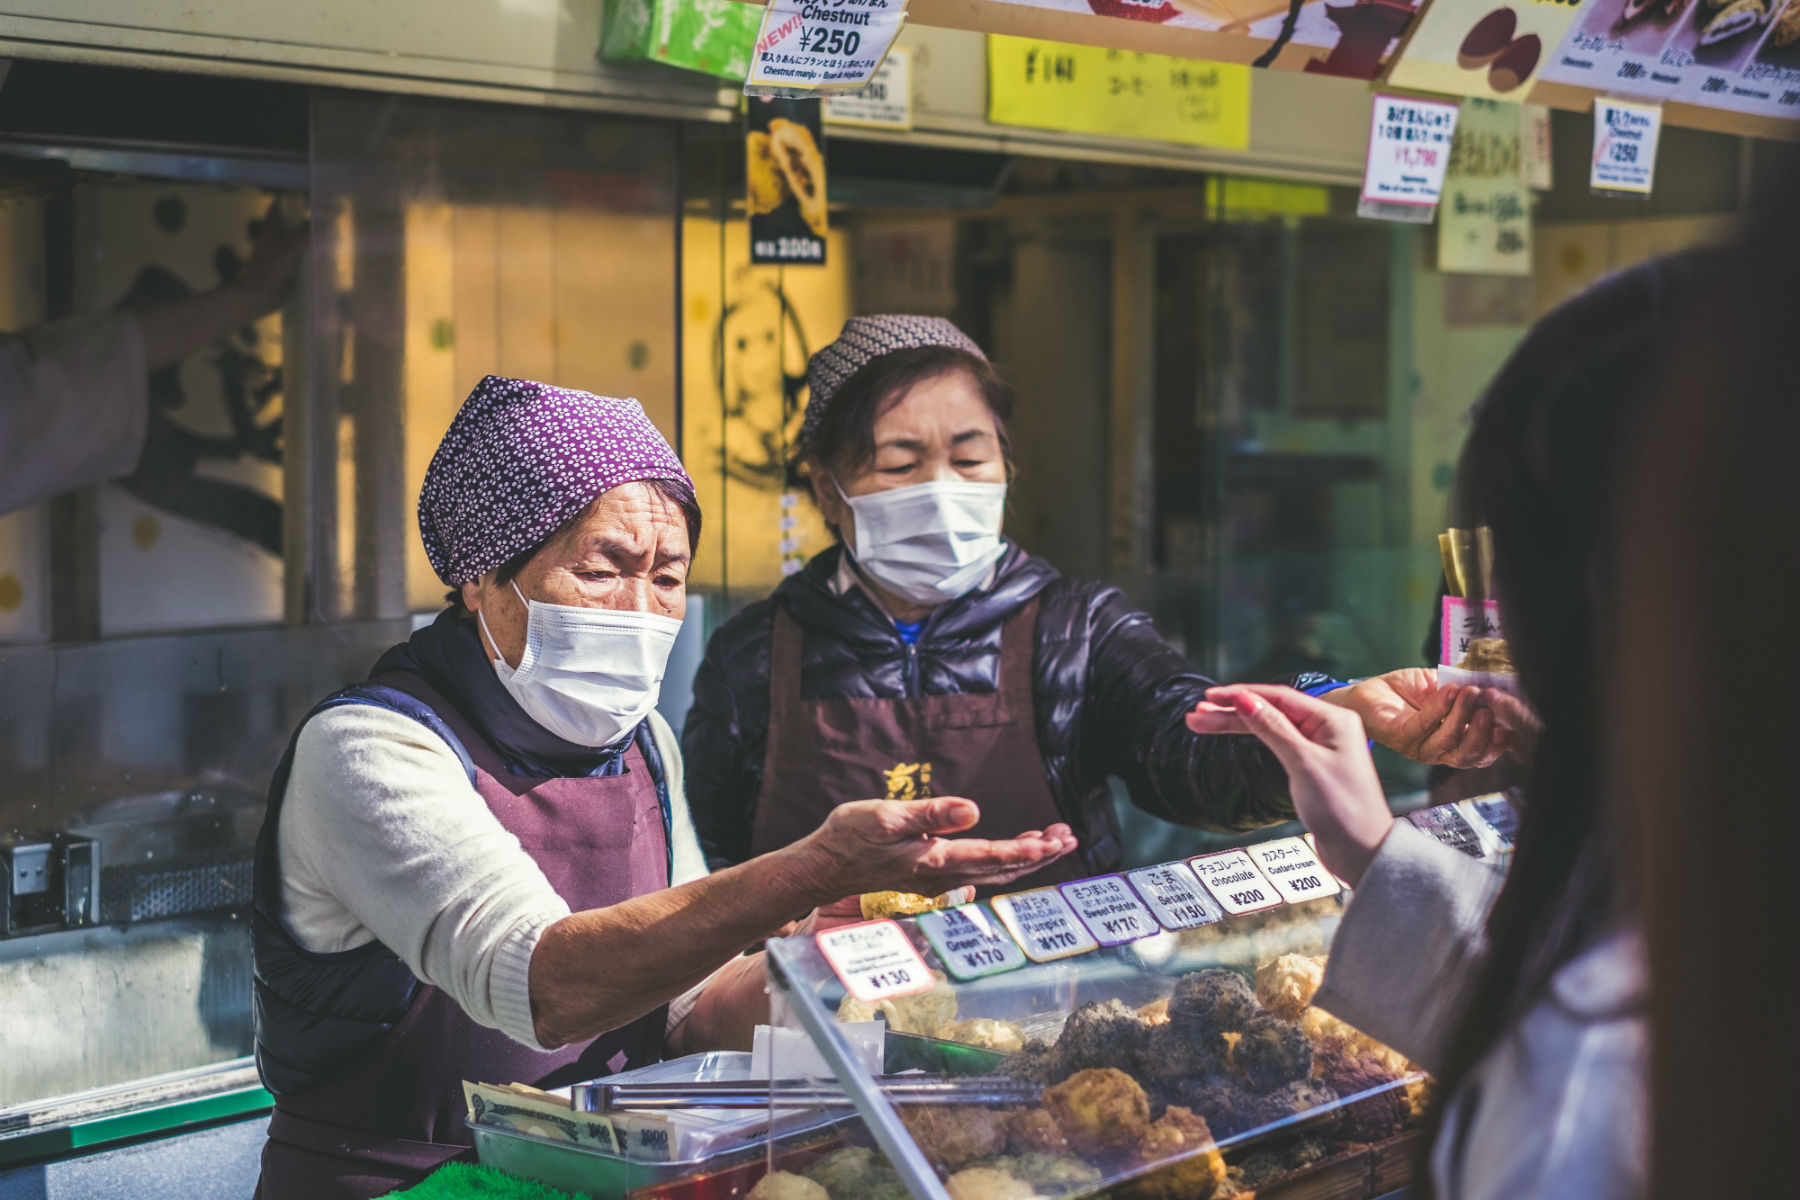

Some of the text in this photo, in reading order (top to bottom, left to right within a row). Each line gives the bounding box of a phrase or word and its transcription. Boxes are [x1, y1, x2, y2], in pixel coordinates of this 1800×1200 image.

[801, 5, 870, 26] Chestnut
[756, 13, 803, 56] NEW!!
[799, 26, 860, 55] ¥250
[763, 66, 795, 77] Chestnut
[795, 70, 817, 80] manju
[1262, 846, 1301, 862] カスタード
[1198, 857, 1247, 875] チョコレート
[1268, 860, 1316, 875] Custard cream
[1211, 870, 1256, 887] chocolate
[1288, 875, 1322, 892] ¥200
[1073, 882, 1120, 900] さつまいも
[1229, 889, 1265, 906] ¥200
[1083, 904, 1110, 918] Sweet
[1103, 916, 1140, 935] ¥170
[946, 937, 982, 952] Green
[1037, 931, 1078, 950] ¥170
[963, 948, 1005, 967] ¥170
[869, 969, 911, 989] ¥130
[640, 1128, 669, 1146] 1000
